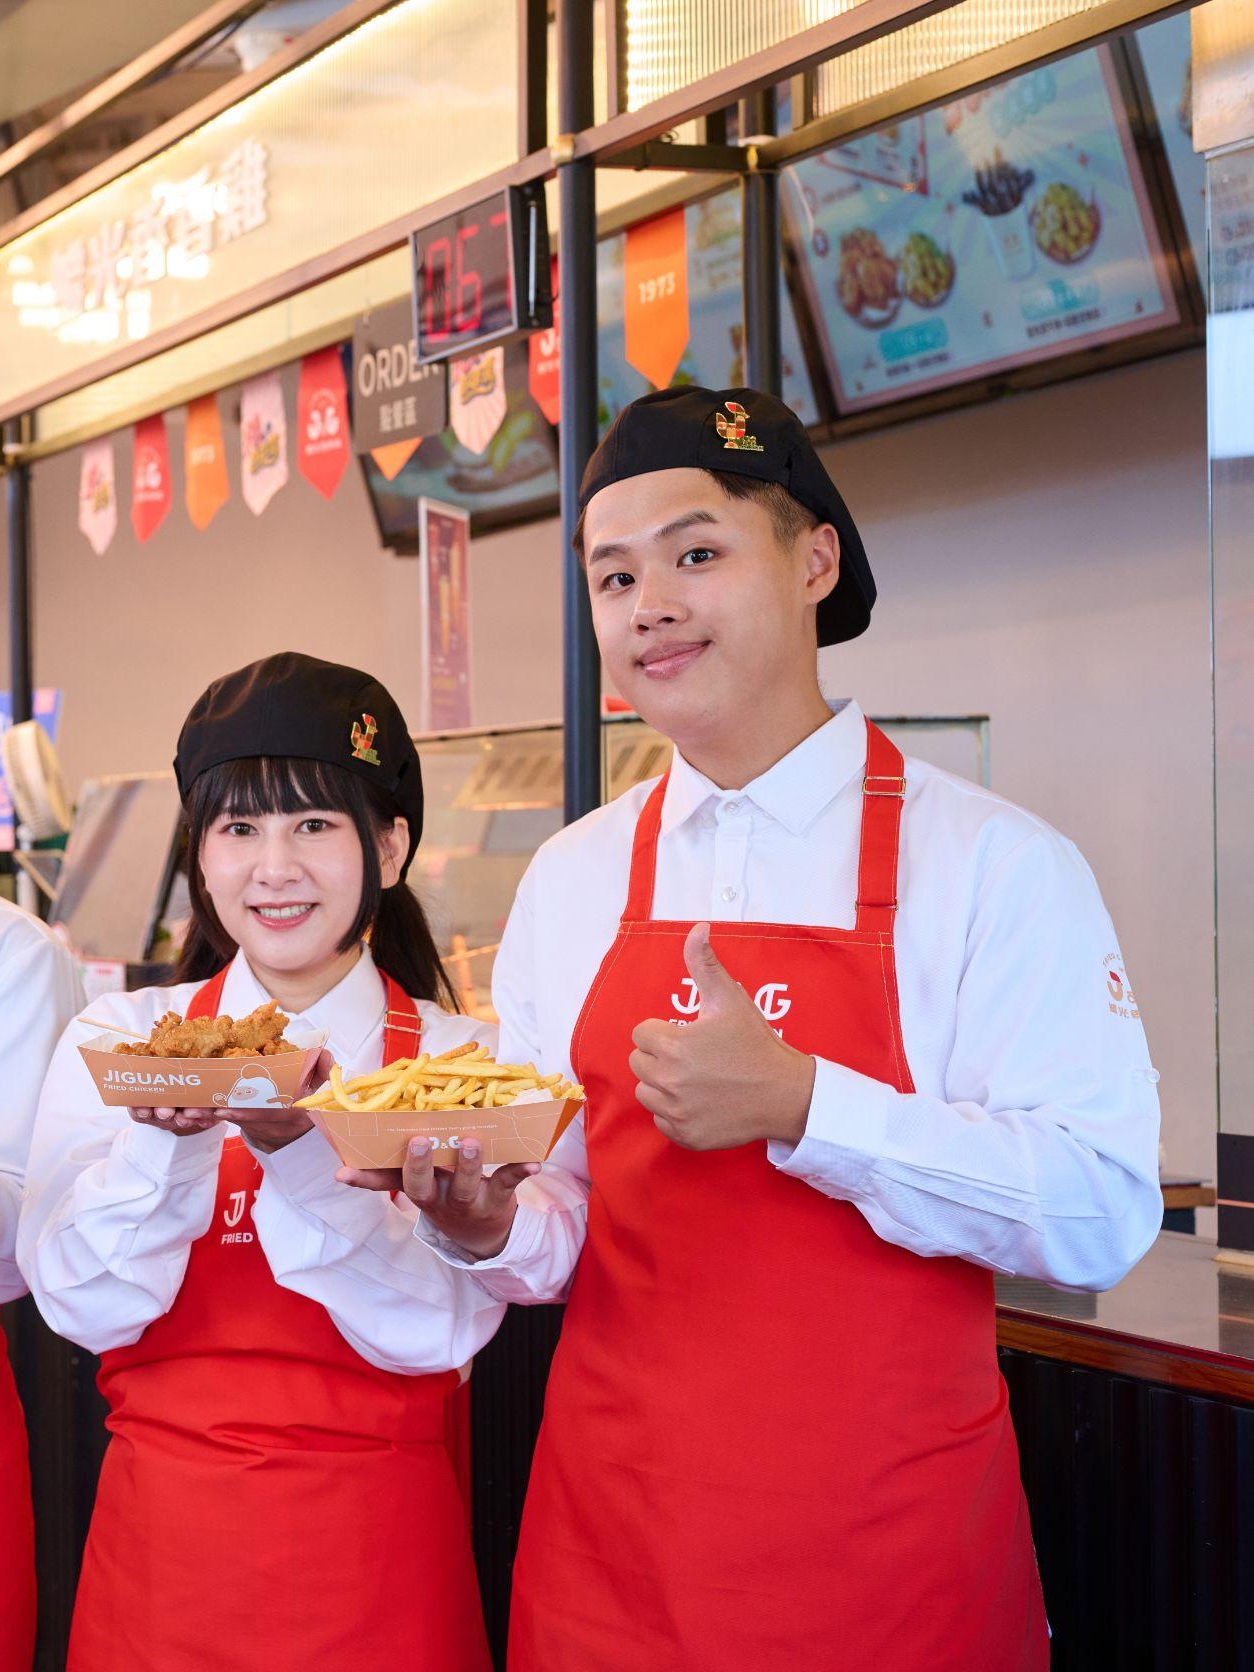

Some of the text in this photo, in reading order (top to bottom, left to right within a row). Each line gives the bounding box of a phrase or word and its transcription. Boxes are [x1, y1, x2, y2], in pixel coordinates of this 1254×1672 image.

[639, 272, 675, 304] 1973
[358, 339, 440, 397] ORDE
[103, 1069, 202, 1087] JIGUANG
[221, 1231, 254, 1245] FRIED
